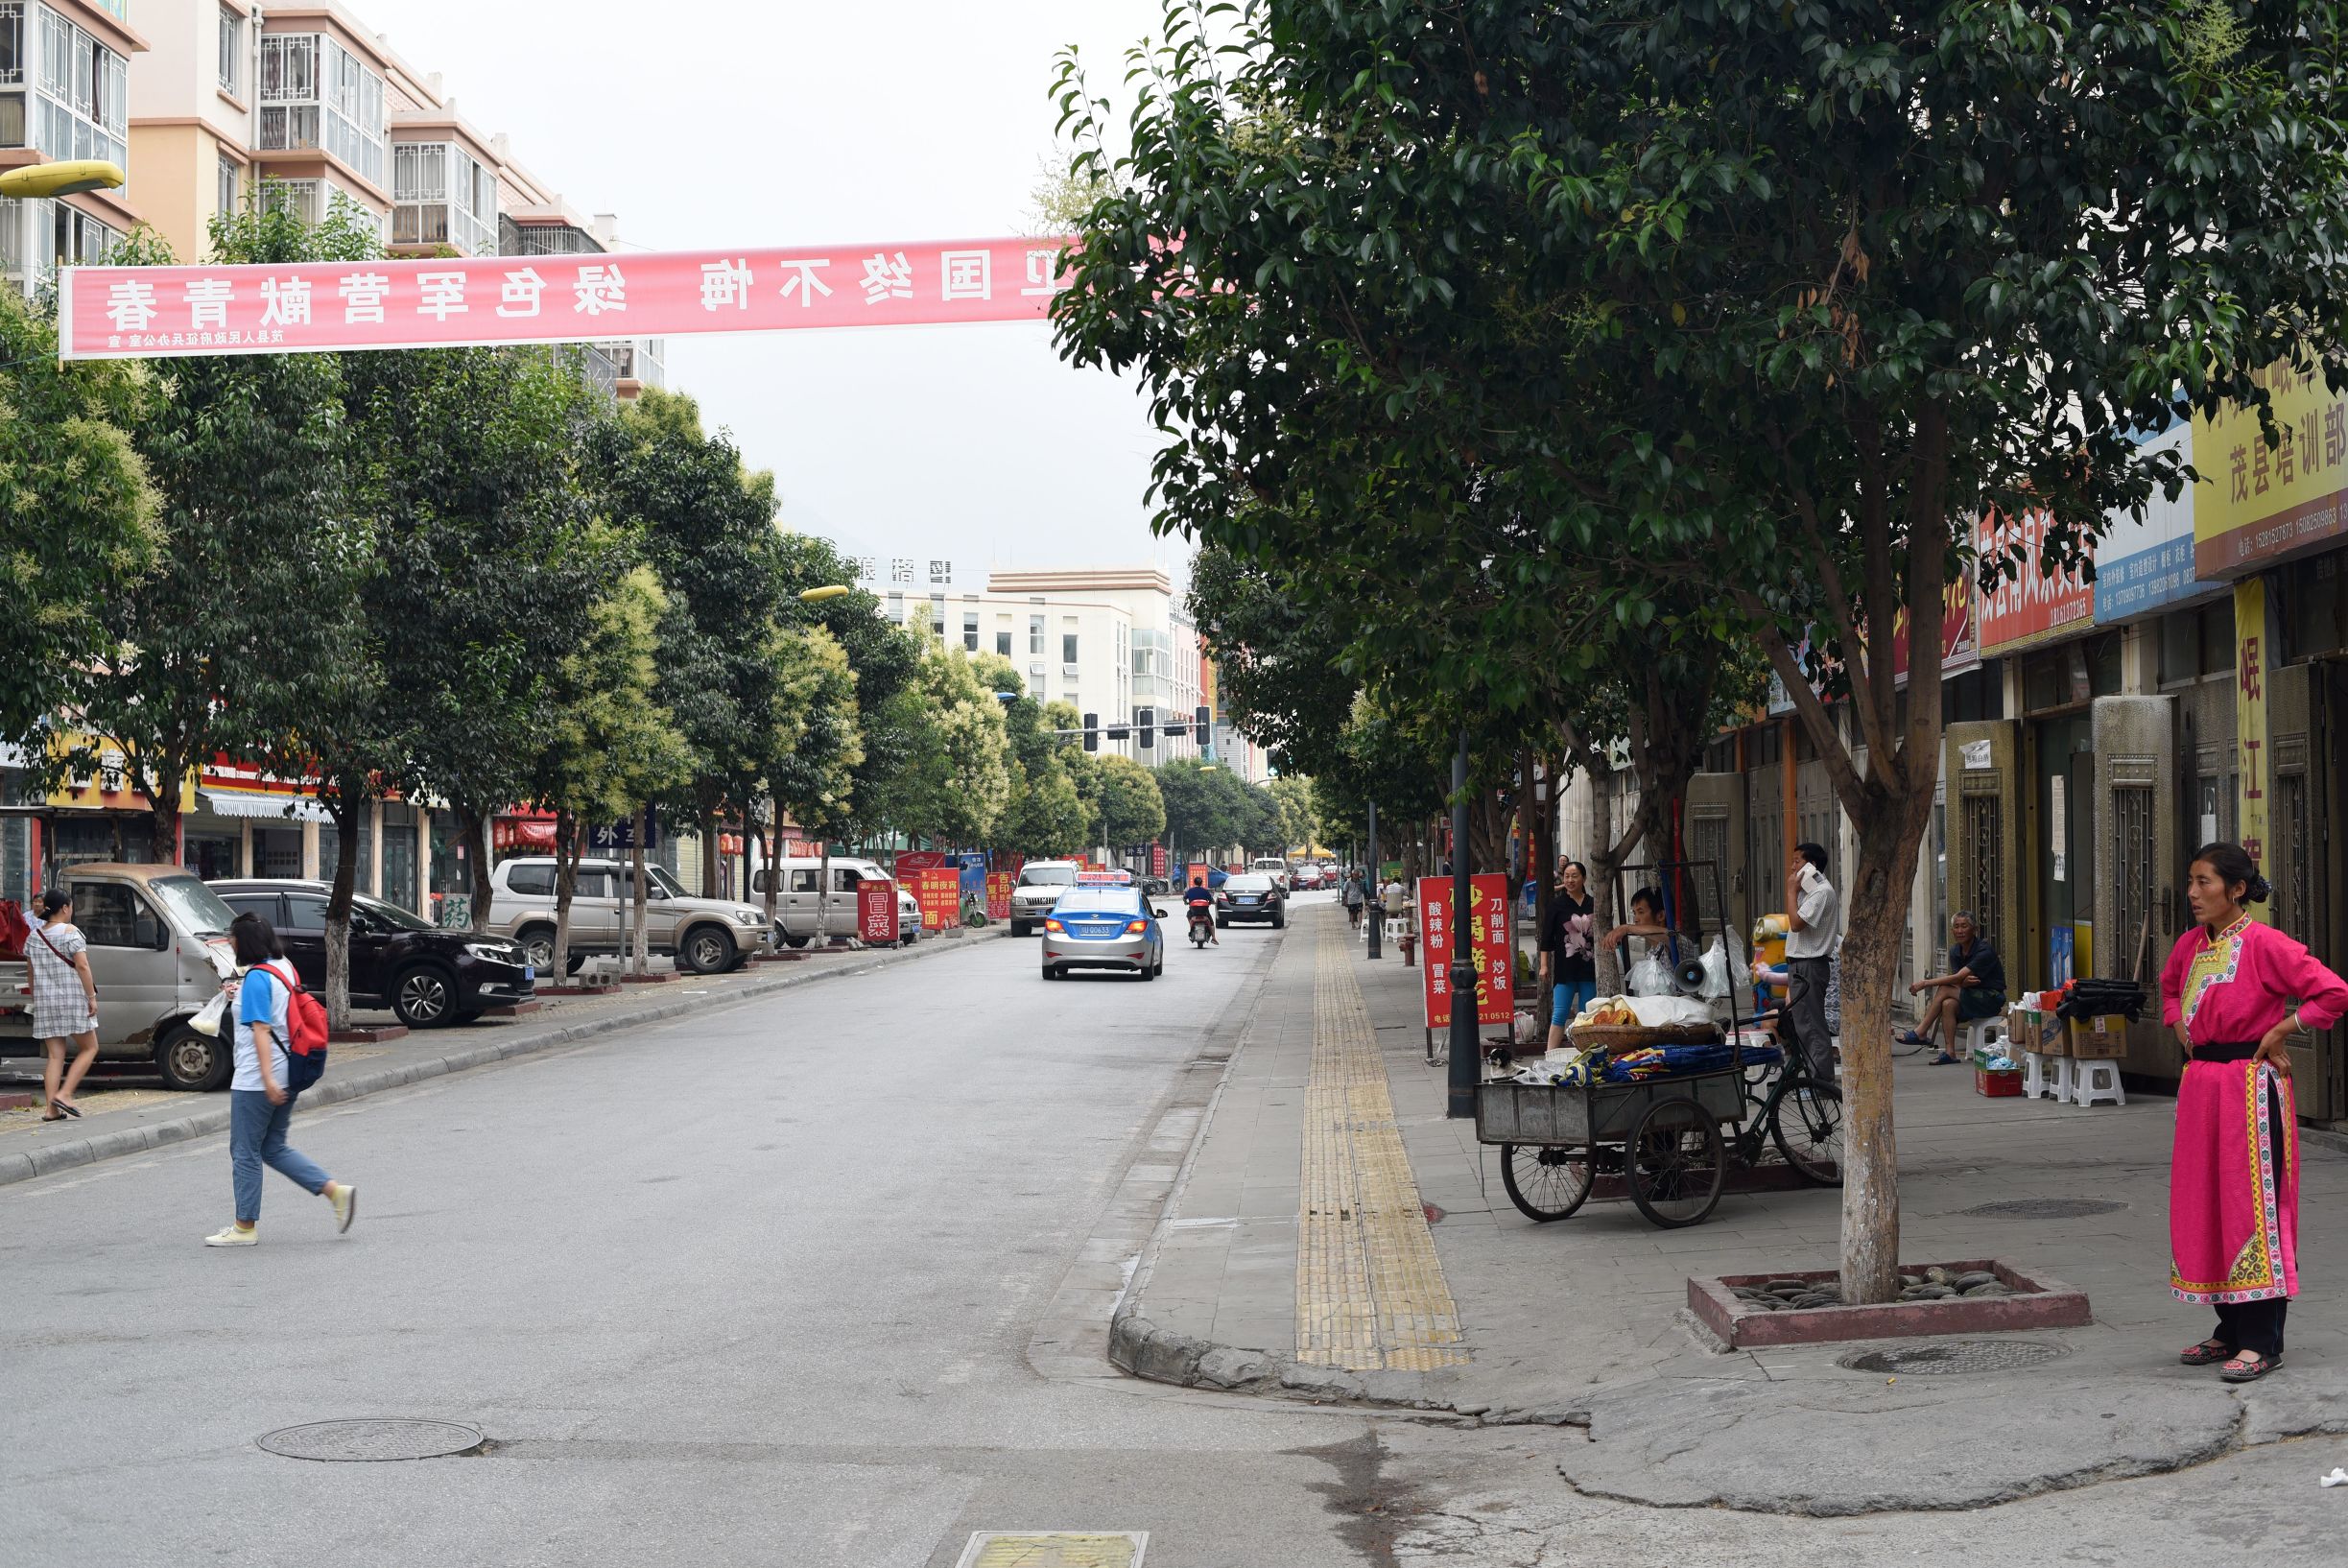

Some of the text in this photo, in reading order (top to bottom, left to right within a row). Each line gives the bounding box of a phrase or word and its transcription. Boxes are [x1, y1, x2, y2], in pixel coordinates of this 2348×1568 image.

[2229, 402, 2347, 506] 茂县培训部
[444, 897, 470, 929] 药
[868, 892, 889, 937] 冒菜
[924, 910, 938, 925] 面
[1428, 901, 1444, 949] 酸辣粉
[1490, 897, 1506, 944] 刀削面
[1432, 962, 1447, 994] 冒菜
[1492, 959, 1507, 990] 炒饭
